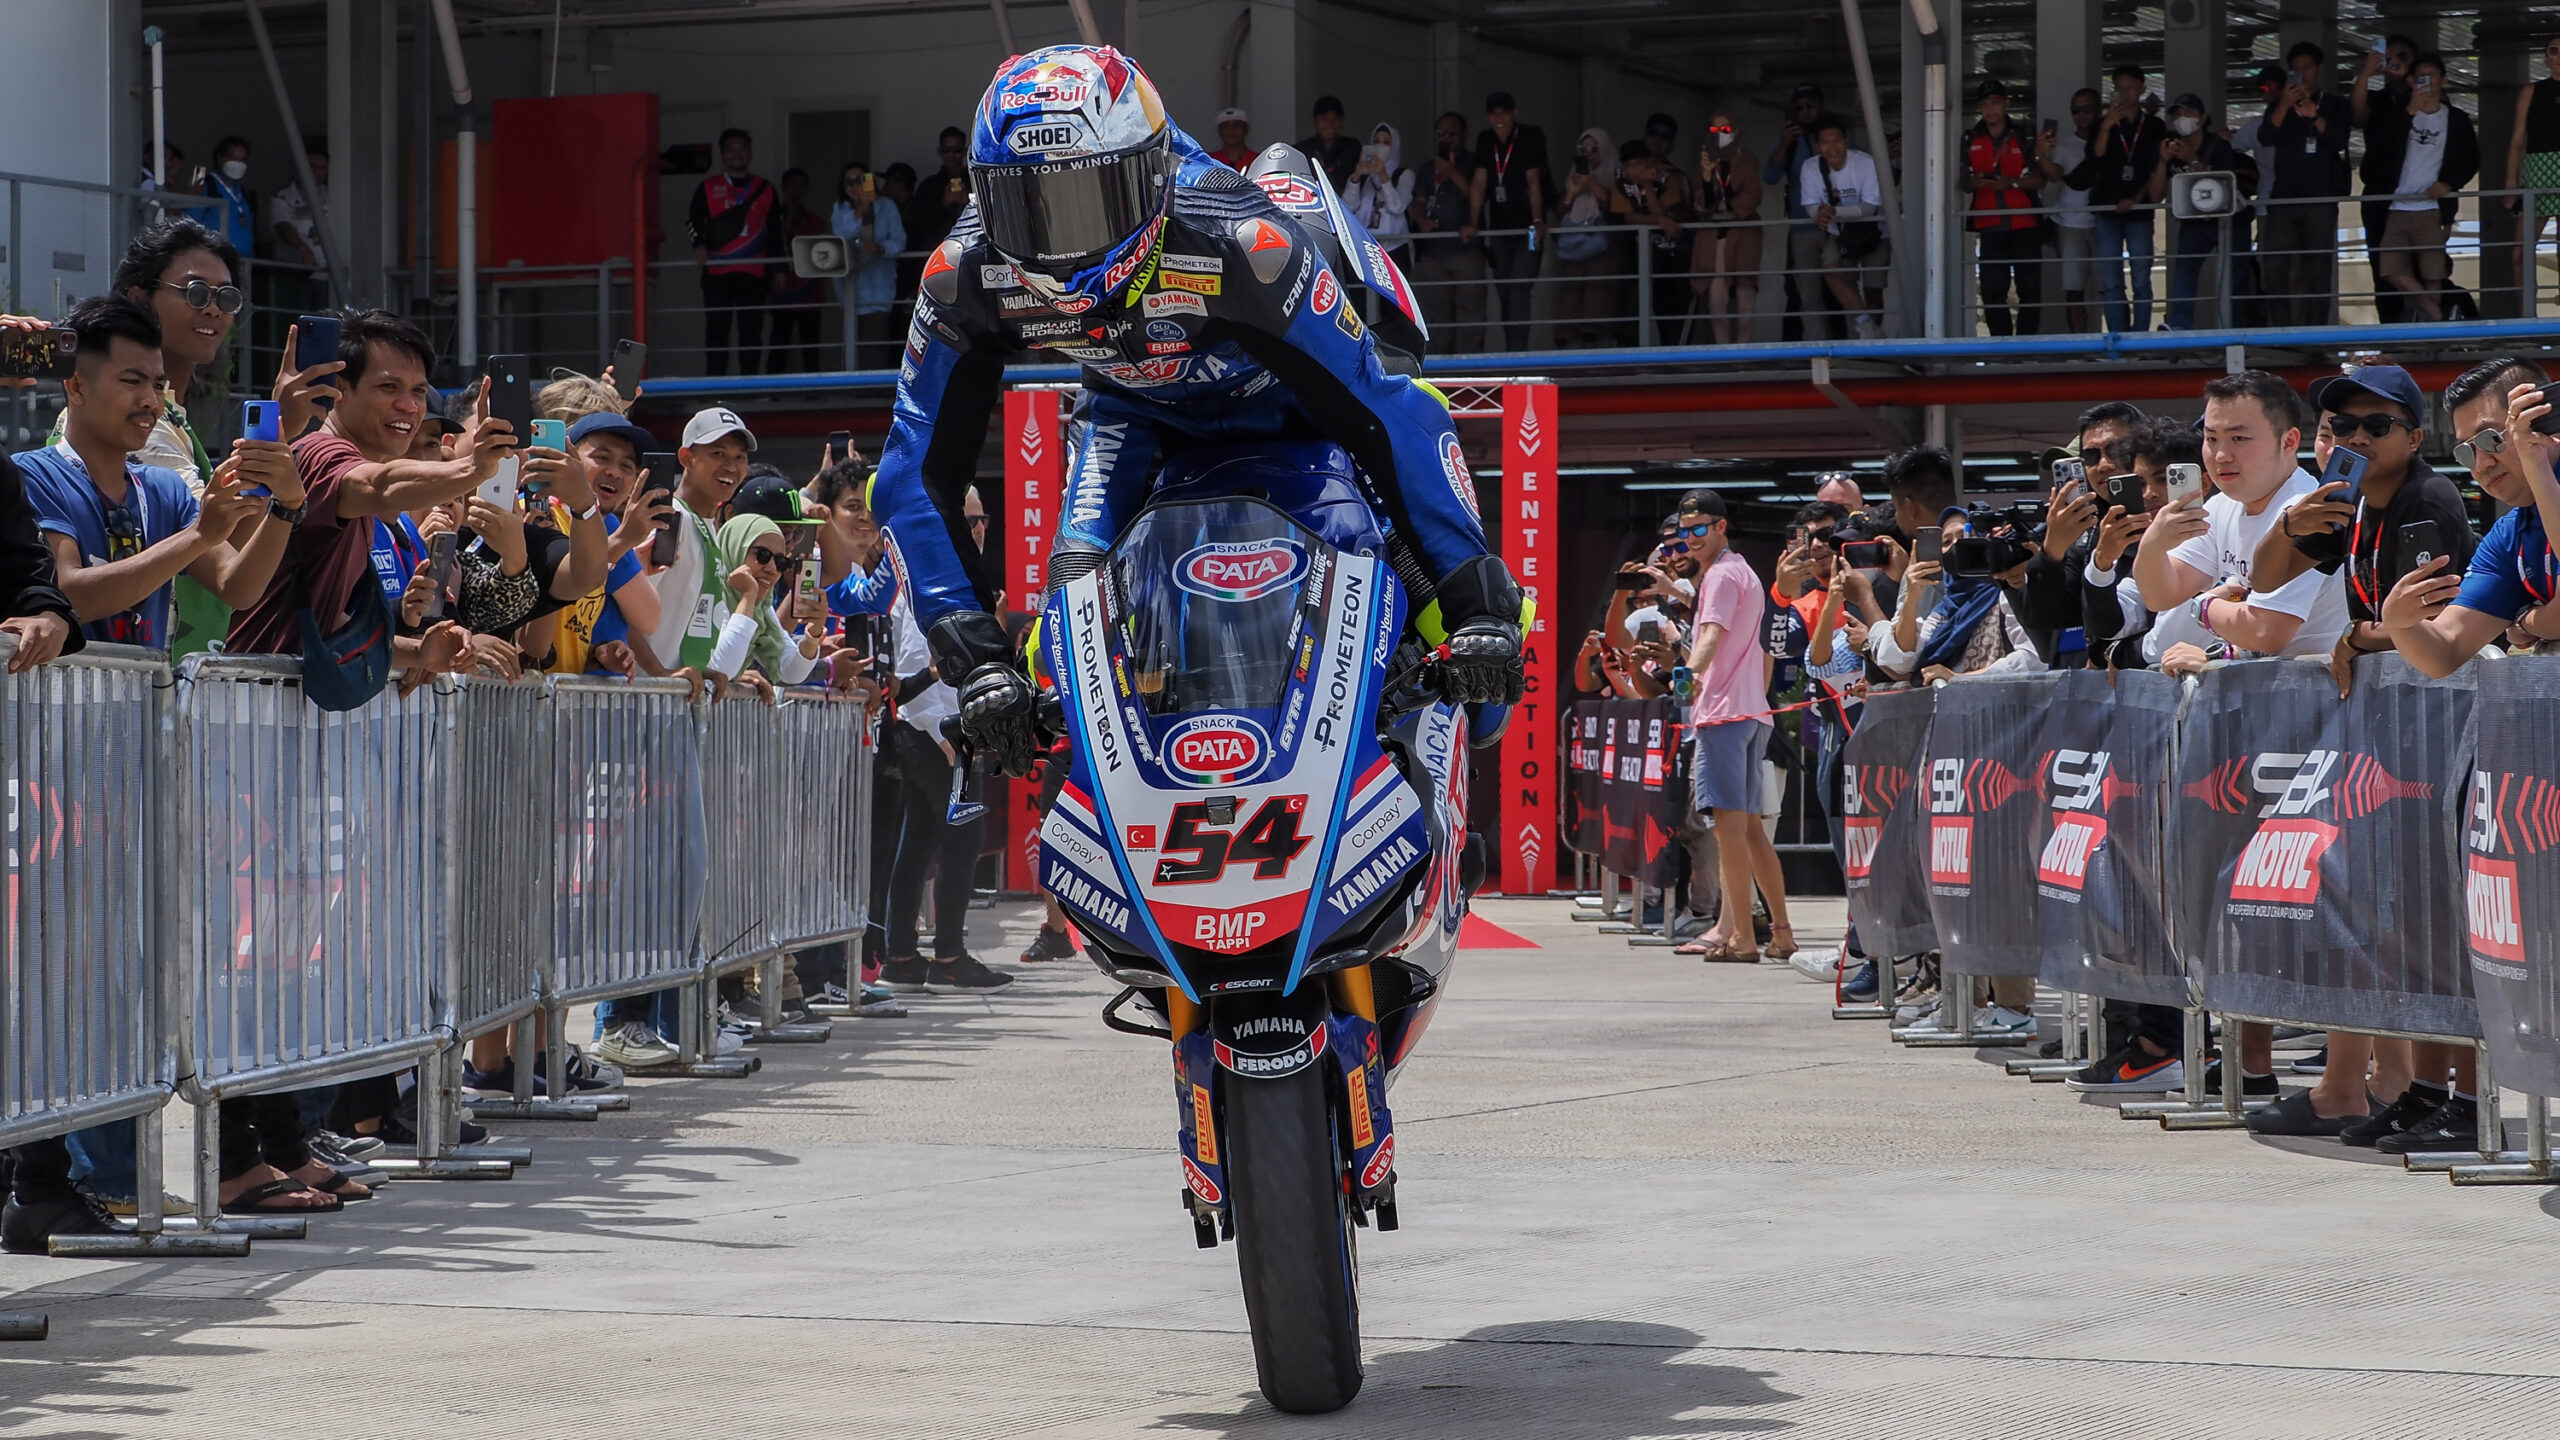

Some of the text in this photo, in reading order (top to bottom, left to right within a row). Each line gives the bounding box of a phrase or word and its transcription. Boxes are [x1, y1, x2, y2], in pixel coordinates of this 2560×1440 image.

[1001, 85, 1087, 109] Red Bull
[1017, 127, 1071, 149] SHOEI
[989, 155, 1121, 177] GIVES YOU WINGS
[1037, 250, 1087, 261] PROMETEON
[1105, 236, 1149, 292] Red
[1162, 256, 1220, 270] PROMETEON
[984, 268, 1019, 284] Corp
[1165, 273, 1216, 292] PIRELLI
[1282, 247, 1312, 317] DAINESE
[1319, 278, 1336, 308] HEL
[1058, 302, 1086, 314] PATA
[1160, 294, 1200, 307] YAMAHA
[1022, 319, 1081, 332] SEMAKIN
[1152, 342, 1187, 351] BMP
[1070, 421, 1130, 526] YAMAHA
[1443, 457, 1465, 501] SNACK
[1022, 480, 1043, 612] ENTER
[1216, 541, 1270, 552] SNACK
[1520, 471, 1540, 605] ENTER
[1203, 558, 1279, 581] PATA
[1120, 622, 1135, 659] WRS
[1287, 609, 1302, 650] WRS
[1313, 574, 1363, 753] PROMETEON
[1124, 706, 1154, 762] GYTR
[1191, 718, 1235, 731] SNACK
[1280, 688, 1304, 752] GYTR
[1520, 647, 1540, 807] ACTION
[1184, 738, 1244, 763] PATA
[1426, 715, 1451, 806] SNACK
[1051, 822, 1097, 864] Corpay
[1152, 793, 1316, 887] 54
[1352, 803, 1401, 849] Corpay
[1932, 826, 1969, 874] MOTUL
[2041, 821, 2094, 878] MOTUL
[2235, 831, 2320, 890] MOTUL
[1327, 835, 1419, 916] YAMAHA
[1048, 860, 1130, 933] YAMAHA
[2468, 869, 2518, 945] MOTUL
[1194, 911, 1266, 939] BMP
[1206, 938, 1250, 950] TAPPI
[1210, 978, 1274, 991] CRESCENT
[1233, 1017, 1306, 1040] YAMAHA
[1238, 1050, 1305, 1071] FERODO
[1195, 1090, 1214, 1158] PIRELLI
[1350, 1073, 1370, 1142] PIRELLI
[1184, 1165, 1210, 1199] HEL
[1370, 1147, 1394, 1181] HEL
